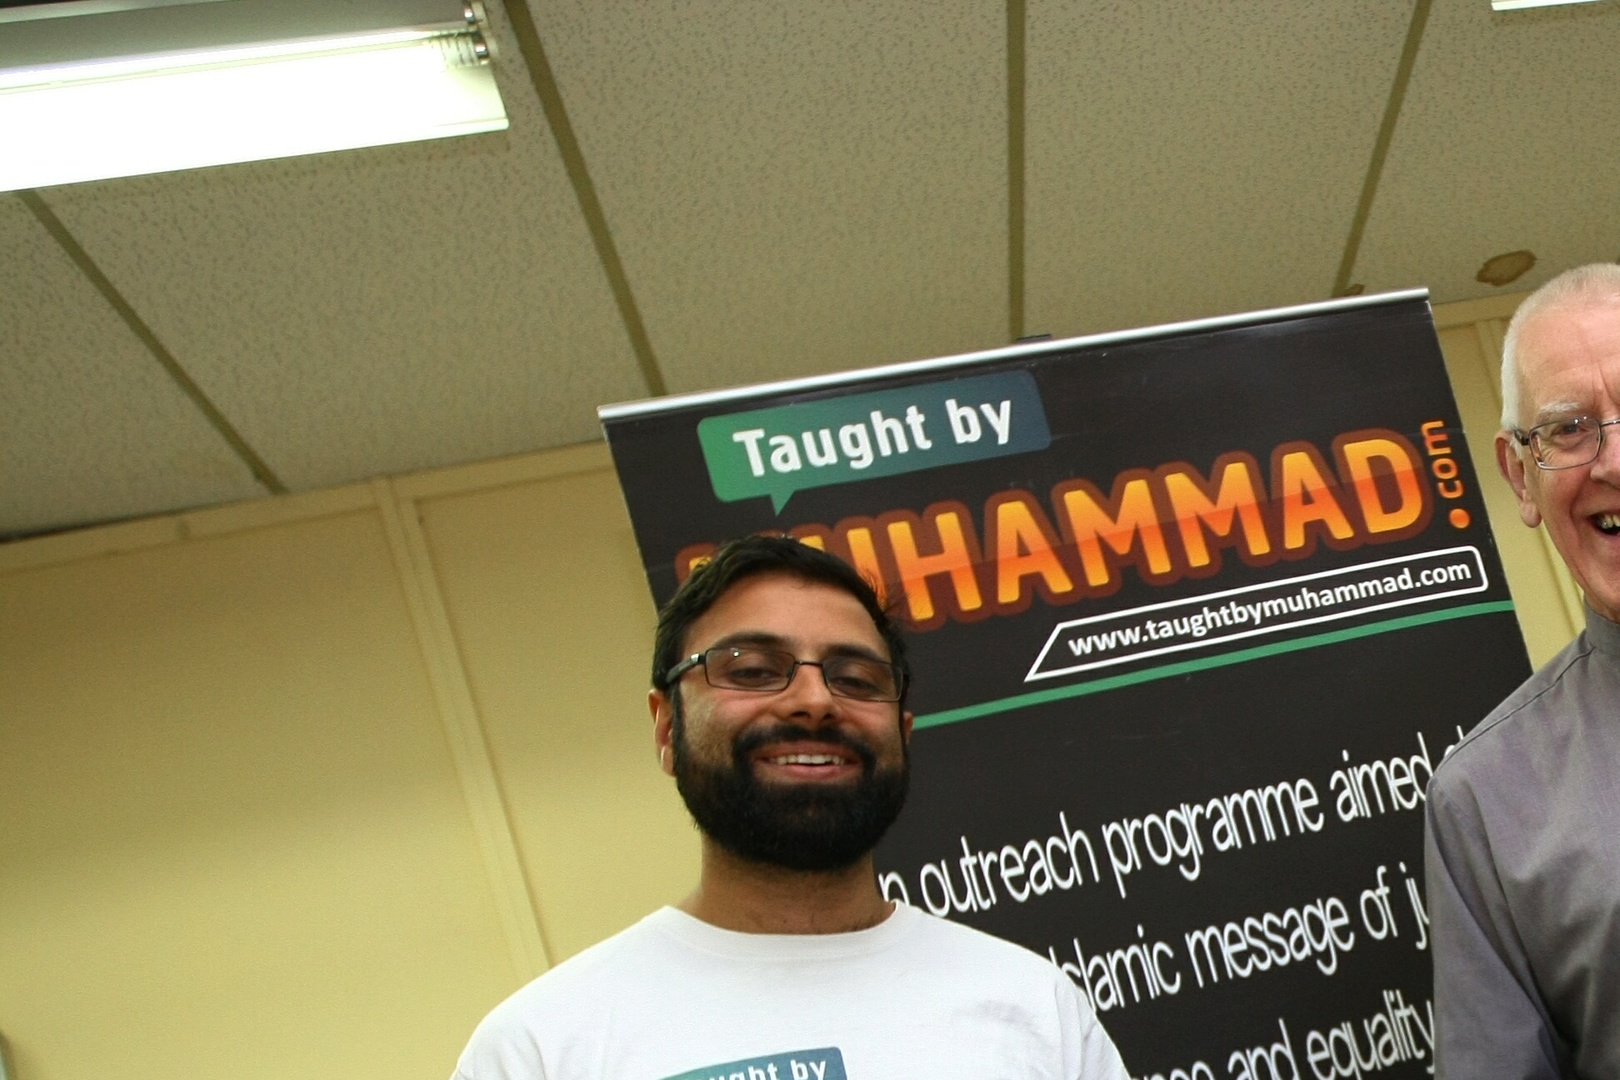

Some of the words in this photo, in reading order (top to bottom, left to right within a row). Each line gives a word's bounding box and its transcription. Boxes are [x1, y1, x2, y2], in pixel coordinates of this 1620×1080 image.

[732, 407, 926, 477] Taught
[945, 395, 1014, 446] by
[1425, 418, 1468, 530] .com
[1068, 561, 1471, 657] www.taughtbymuhammad.com
[921, 811, 1099, 918] outreach
[1101, 778, 1325, 898] programme
[1328, 731, 1433, 821] aimed
[1185, 896, 1355, 976] message
[1360, 866, 1398, 940] of
